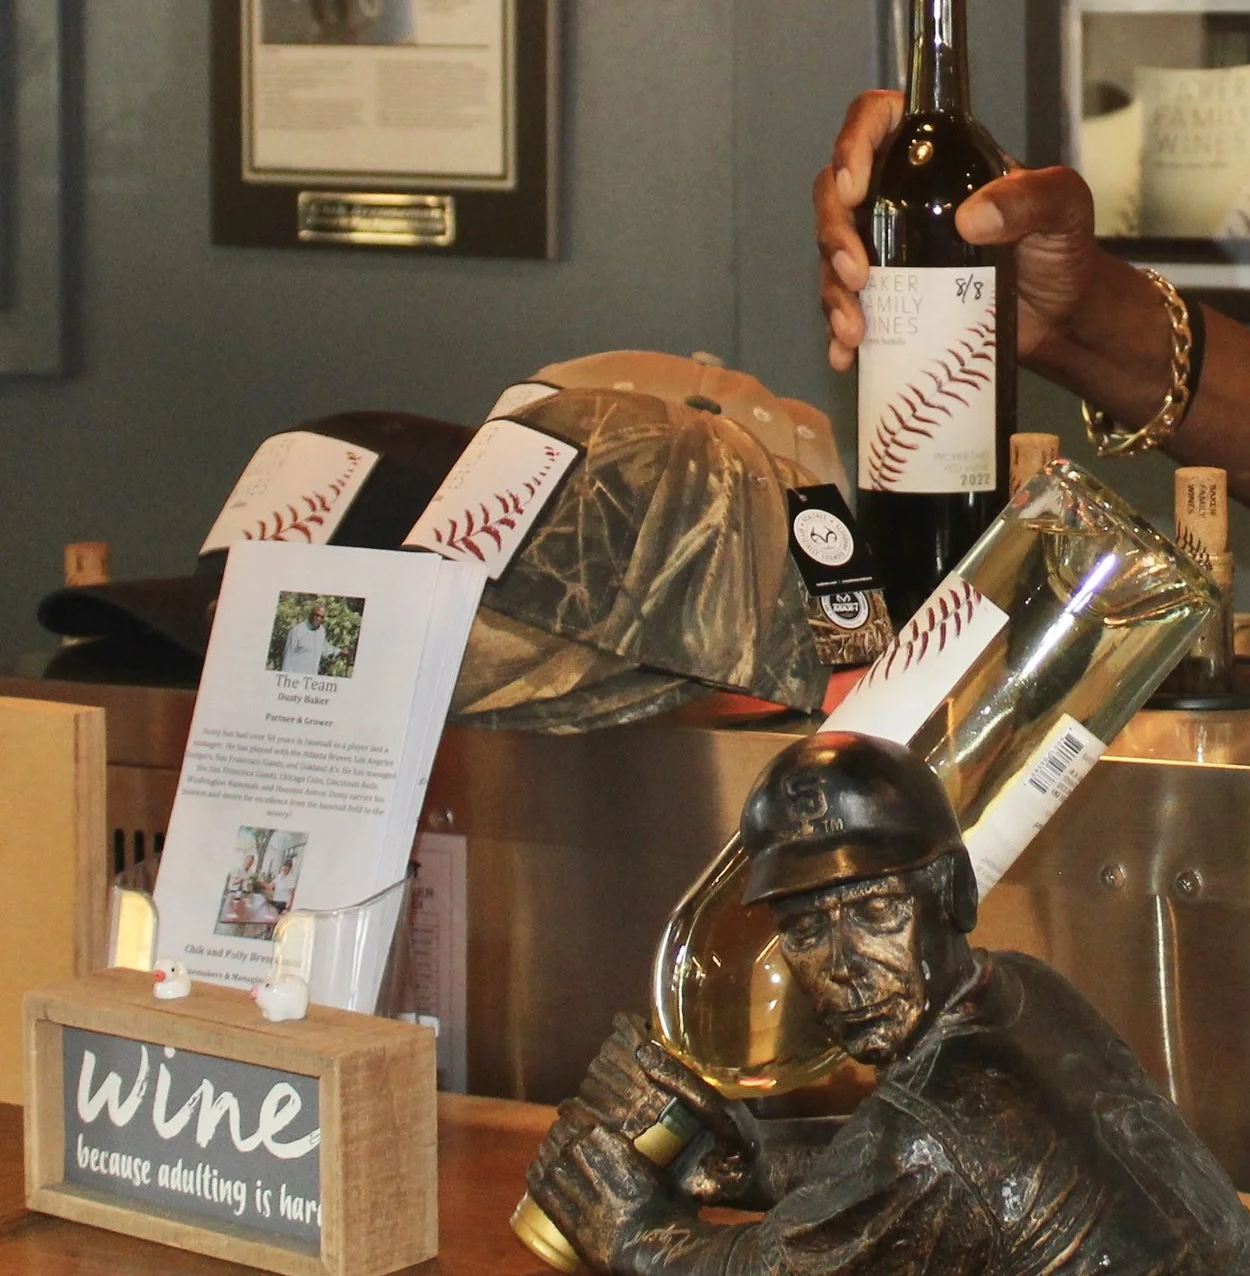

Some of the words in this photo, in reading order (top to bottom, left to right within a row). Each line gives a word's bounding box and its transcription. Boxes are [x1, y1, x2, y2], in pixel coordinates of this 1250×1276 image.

[865, 274, 919, 293] AKER
[954, 273, 985, 305] 8/8
[866, 315, 919, 335] INES
[275, 673, 300, 688] The
[302, 676, 338, 692] Team
[278, 692, 301, 703] Dusty
[304, 694, 330, 705] Baker
[265, 713, 294, 723] Partner
[304, 717, 334, 727] Grower
[76, 1132, 151, 1187] because
[157, 1158, 247, 1215] adulting
[255, 1180, 272, 1218] is
